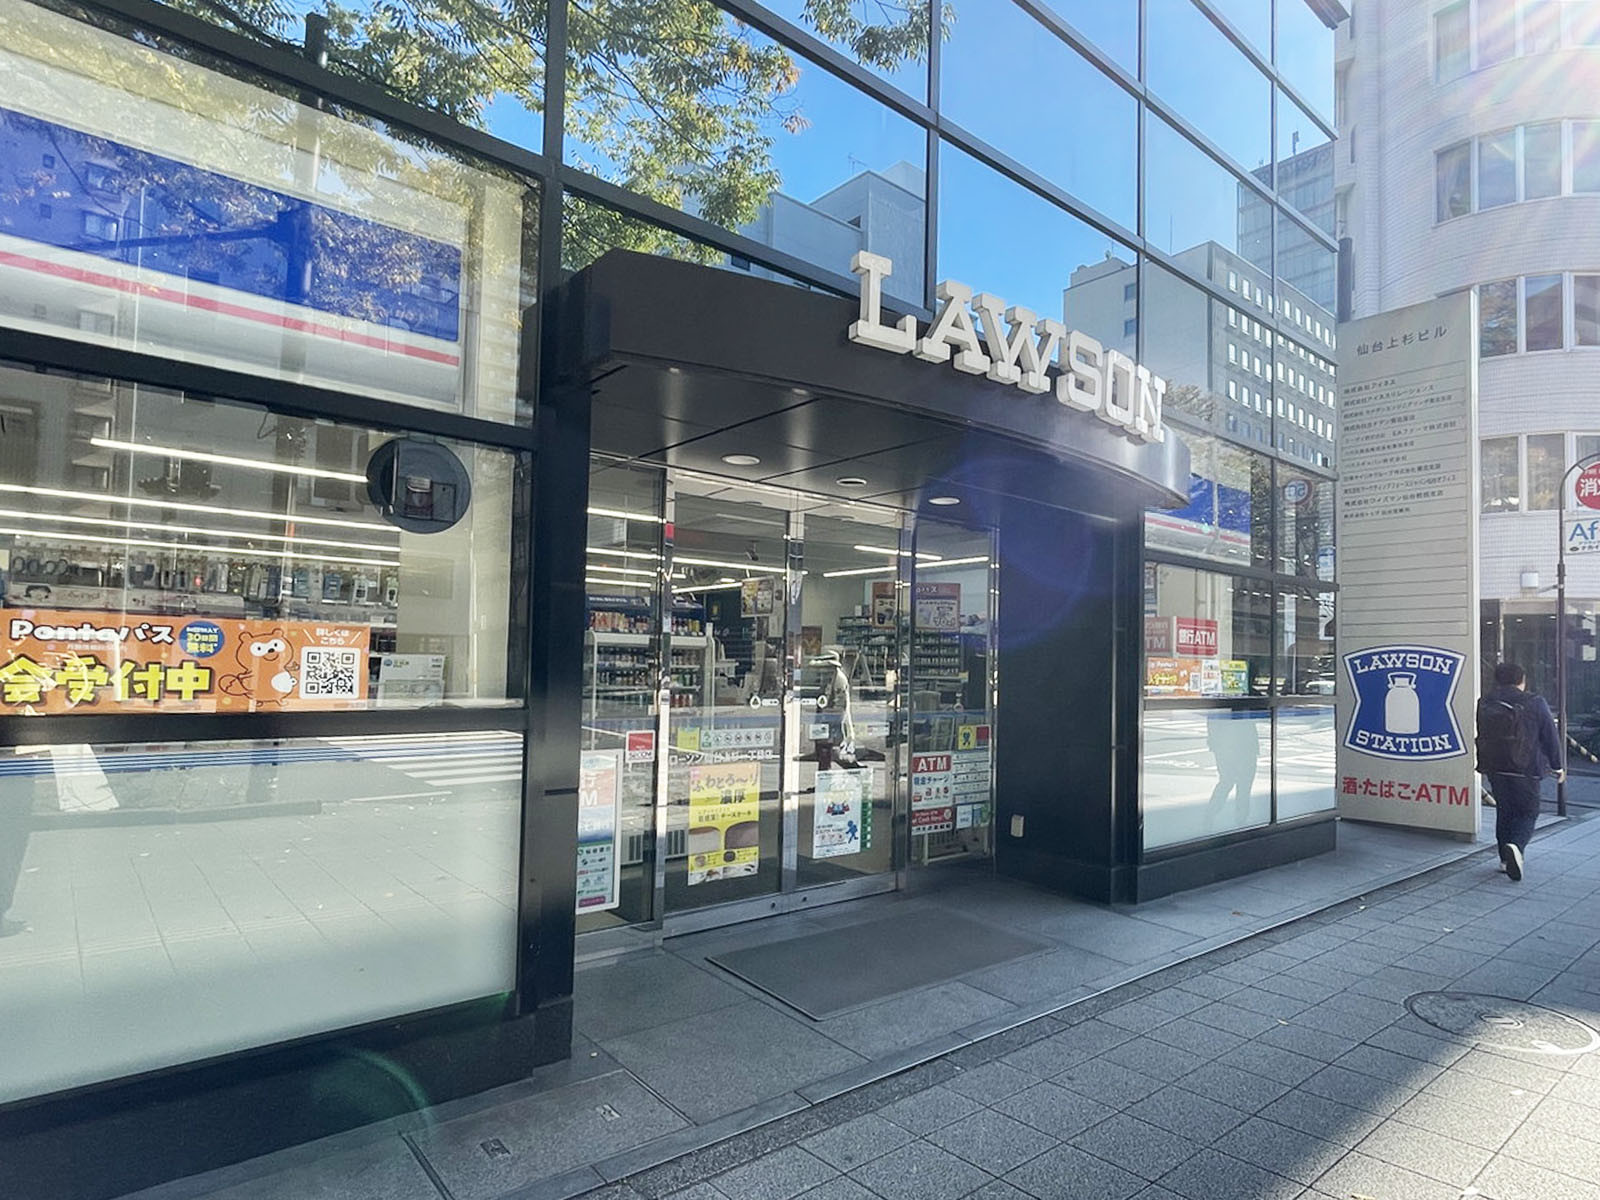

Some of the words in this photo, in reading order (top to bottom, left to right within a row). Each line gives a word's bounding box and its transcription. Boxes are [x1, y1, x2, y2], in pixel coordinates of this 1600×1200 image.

[849, 250, 1167, 443] LAWSON
[1356, 325, 1448, 357] 仙台上杉ビル
[11, 619, 175, 644] Pontaパス
[316, 628, 350, 637] 詳しくは
[320, 637, 345, 645] こちら
[1353, 653, 1453, 675] LAWSON
[1356, 731, 1452, 754] STATION
[917, 757, 948, 772] ATM
